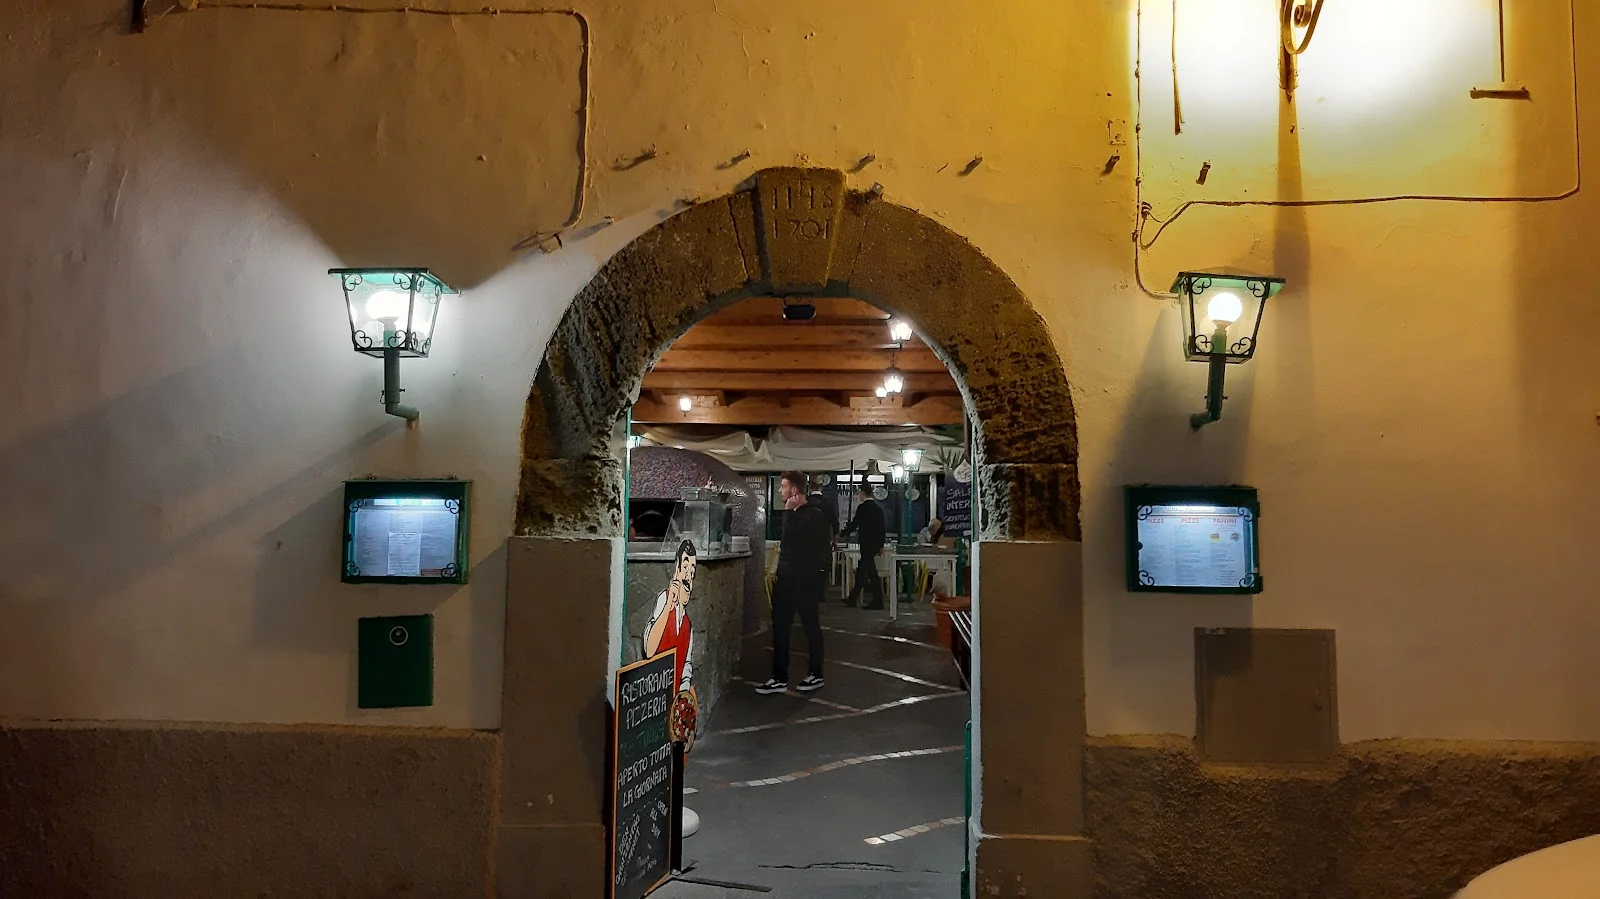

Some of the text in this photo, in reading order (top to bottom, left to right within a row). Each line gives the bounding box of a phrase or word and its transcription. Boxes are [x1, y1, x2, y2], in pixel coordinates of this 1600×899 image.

[773, 218, 831, 240] 1701
[946, 500, 972, 511] INTER
[621, 667, 675, 706] RISTORANTE
[626, 693, 668, 730] PIZZERIA
[617, 741, 672, 791] APERTO TUTTA
[622, 765, 668, 808] LA GIORNATA
